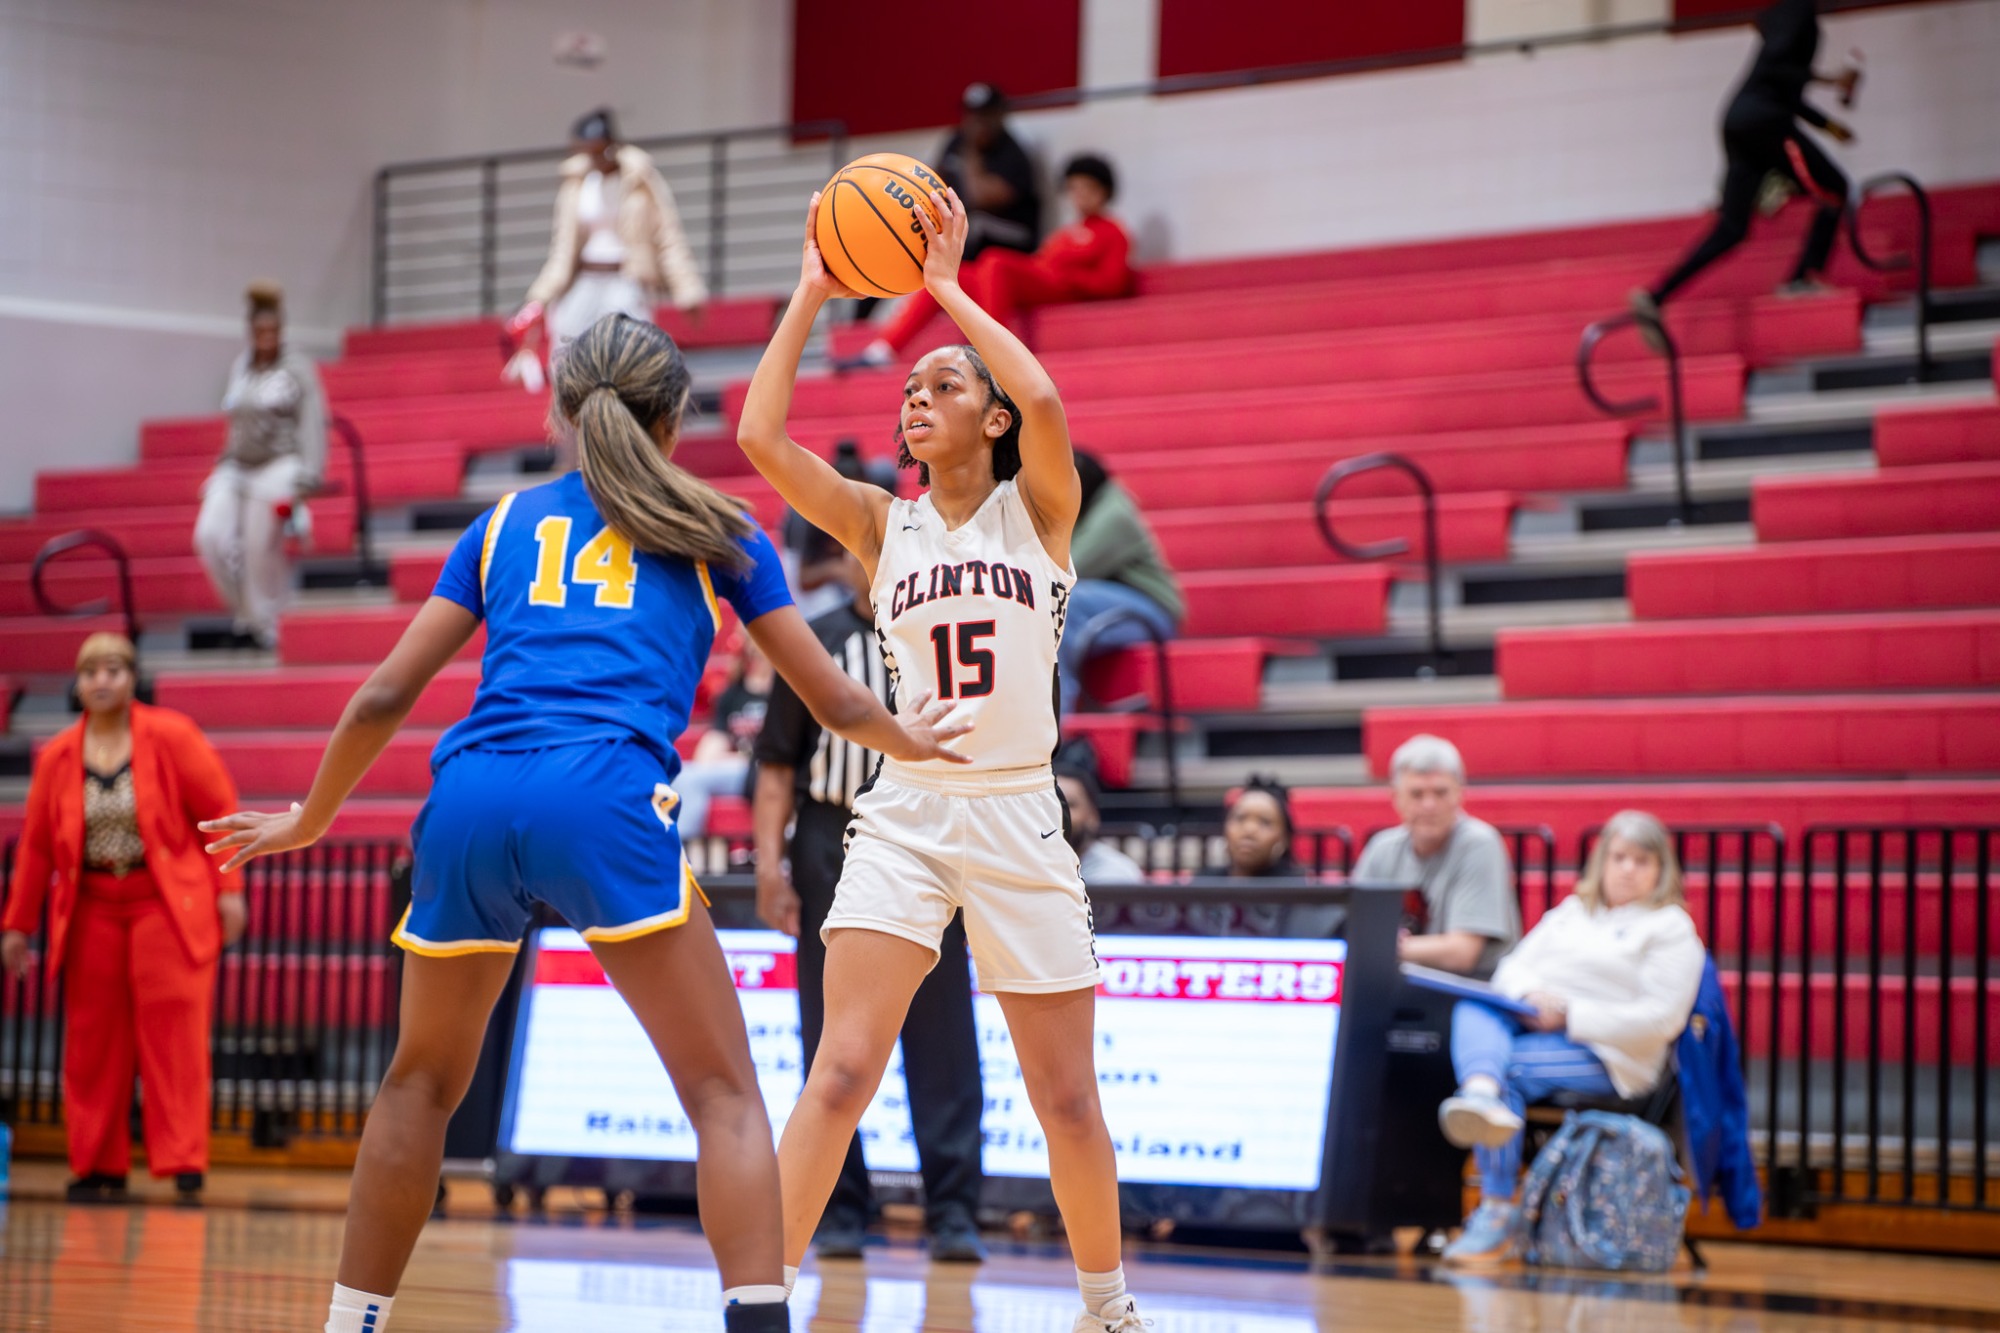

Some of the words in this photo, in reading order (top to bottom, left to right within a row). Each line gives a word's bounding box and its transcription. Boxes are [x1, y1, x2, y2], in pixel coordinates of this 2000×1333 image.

[528, 515, 638, 610] 14
[891, 560, 1035, 622] CLINTON
[930, 619, 995, 701] 15
[1099, 959, 1339, 1001] ORTERS
